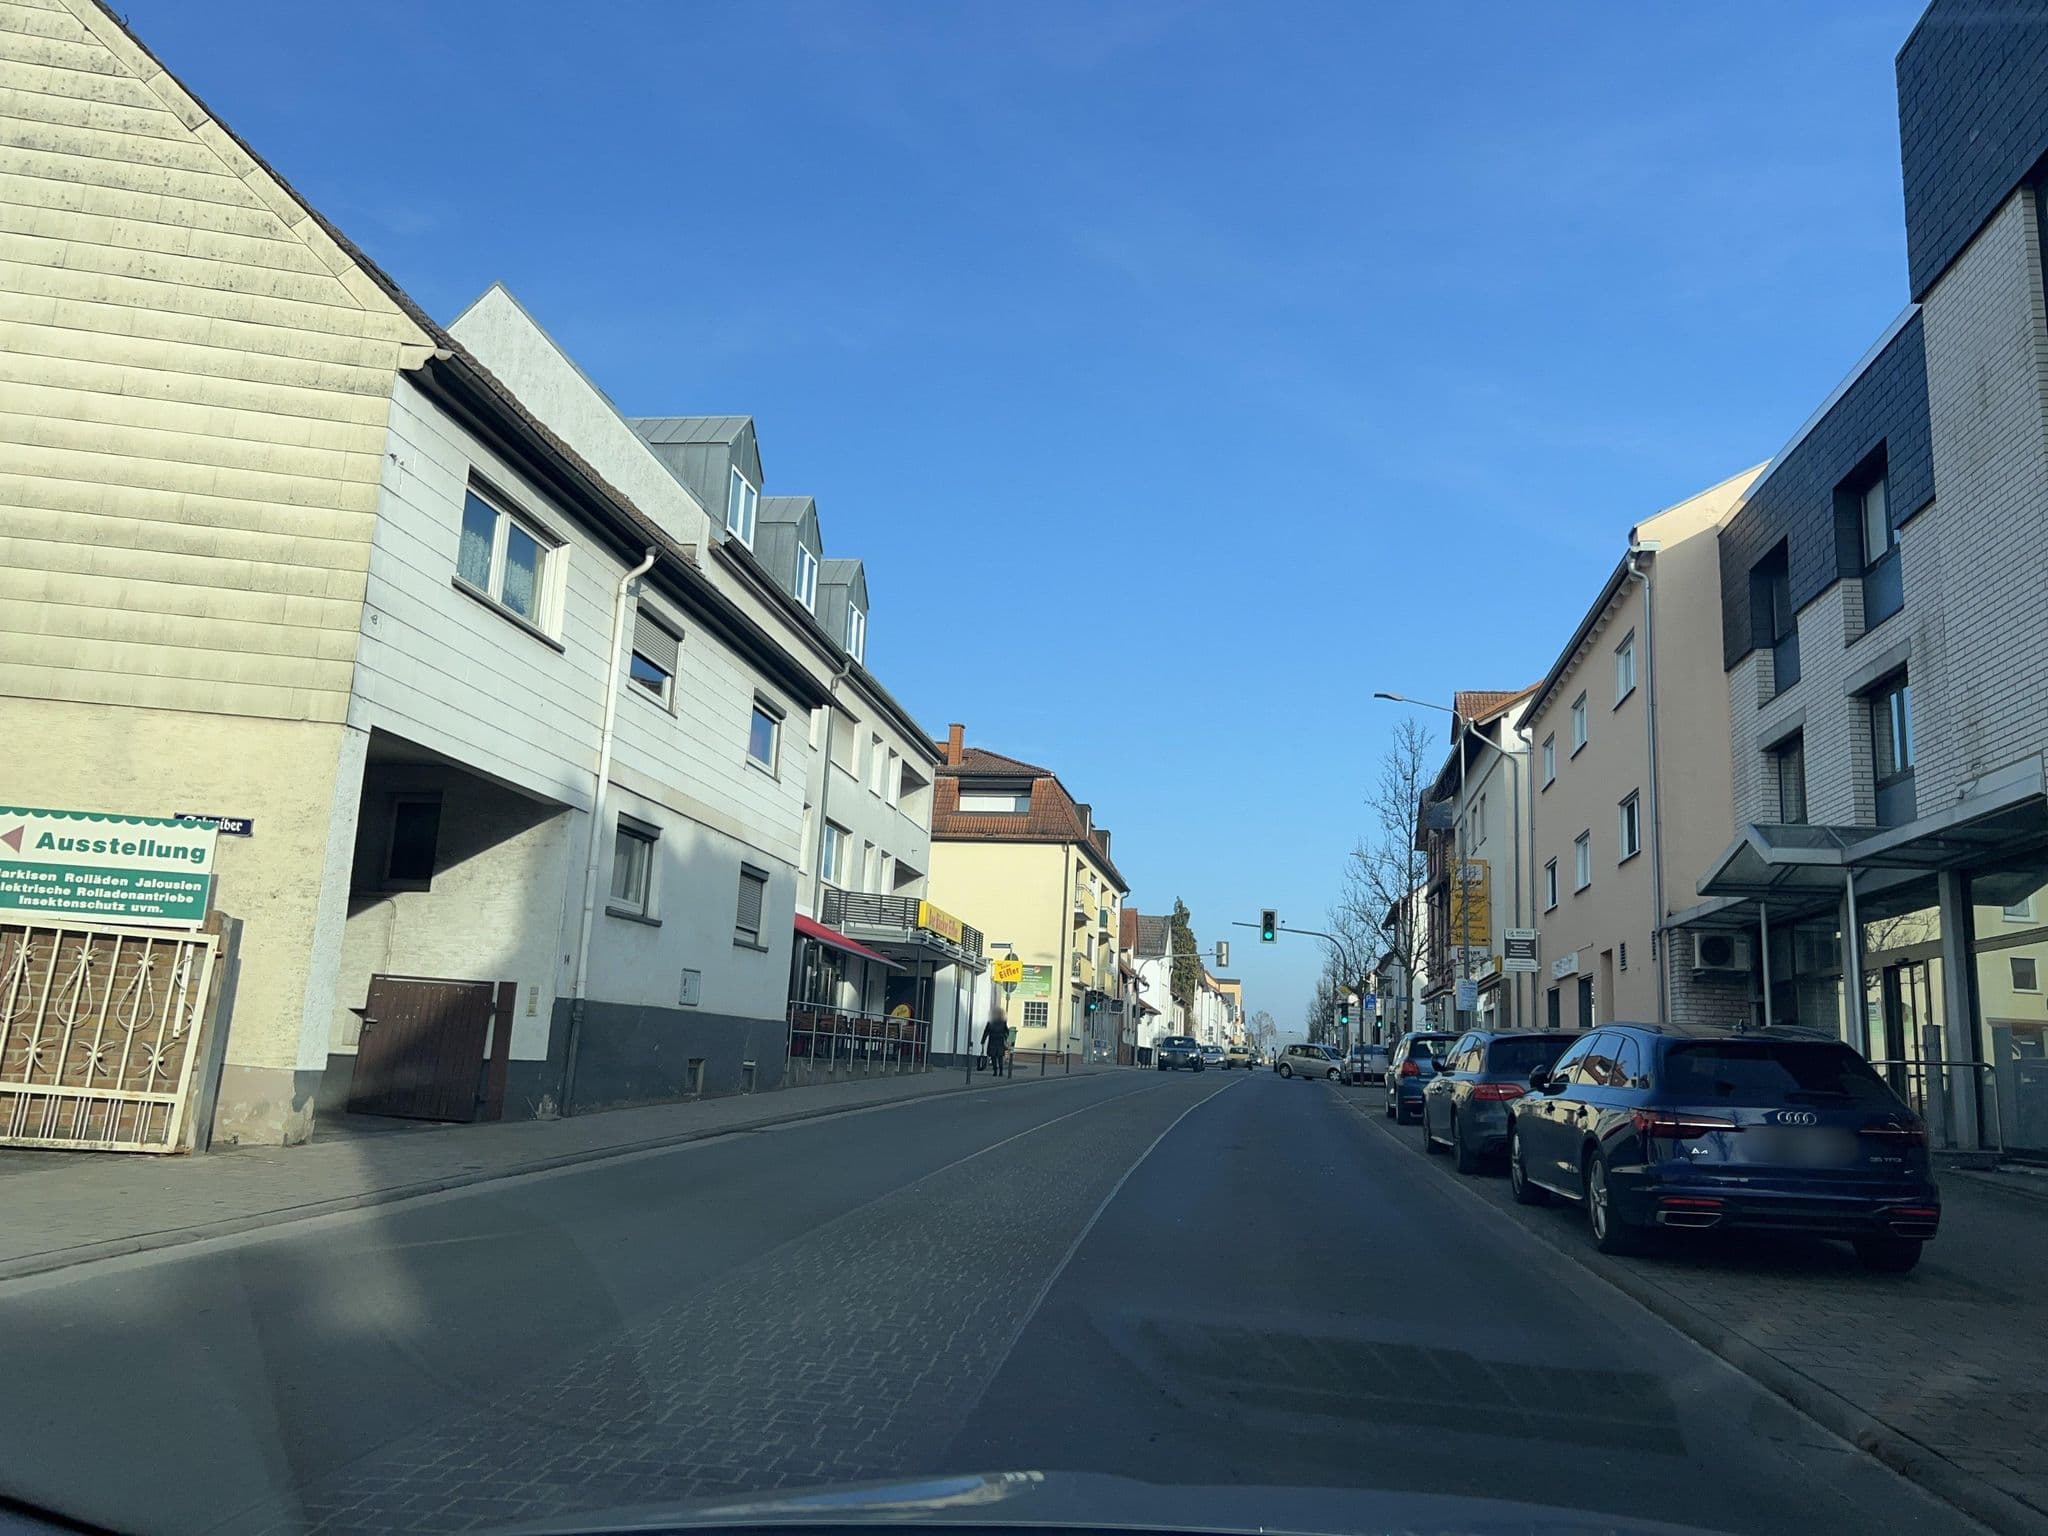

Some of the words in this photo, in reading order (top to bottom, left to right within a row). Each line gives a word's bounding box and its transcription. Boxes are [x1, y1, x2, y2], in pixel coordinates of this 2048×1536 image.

[35, 831, 207, 864] Ausstellung
[0, 868, 57, 882] arkisen
[64, 873, 129, 887] Rolläden
[135, 877, 202, 892] Jalousien
[0, 882, 71, 896] lektrische
[77, 887, 194, 904] Rolladenantriebe
[19, 895, 126, 911] Insektenschutz
[131, 903, 164, 914] uvm.
